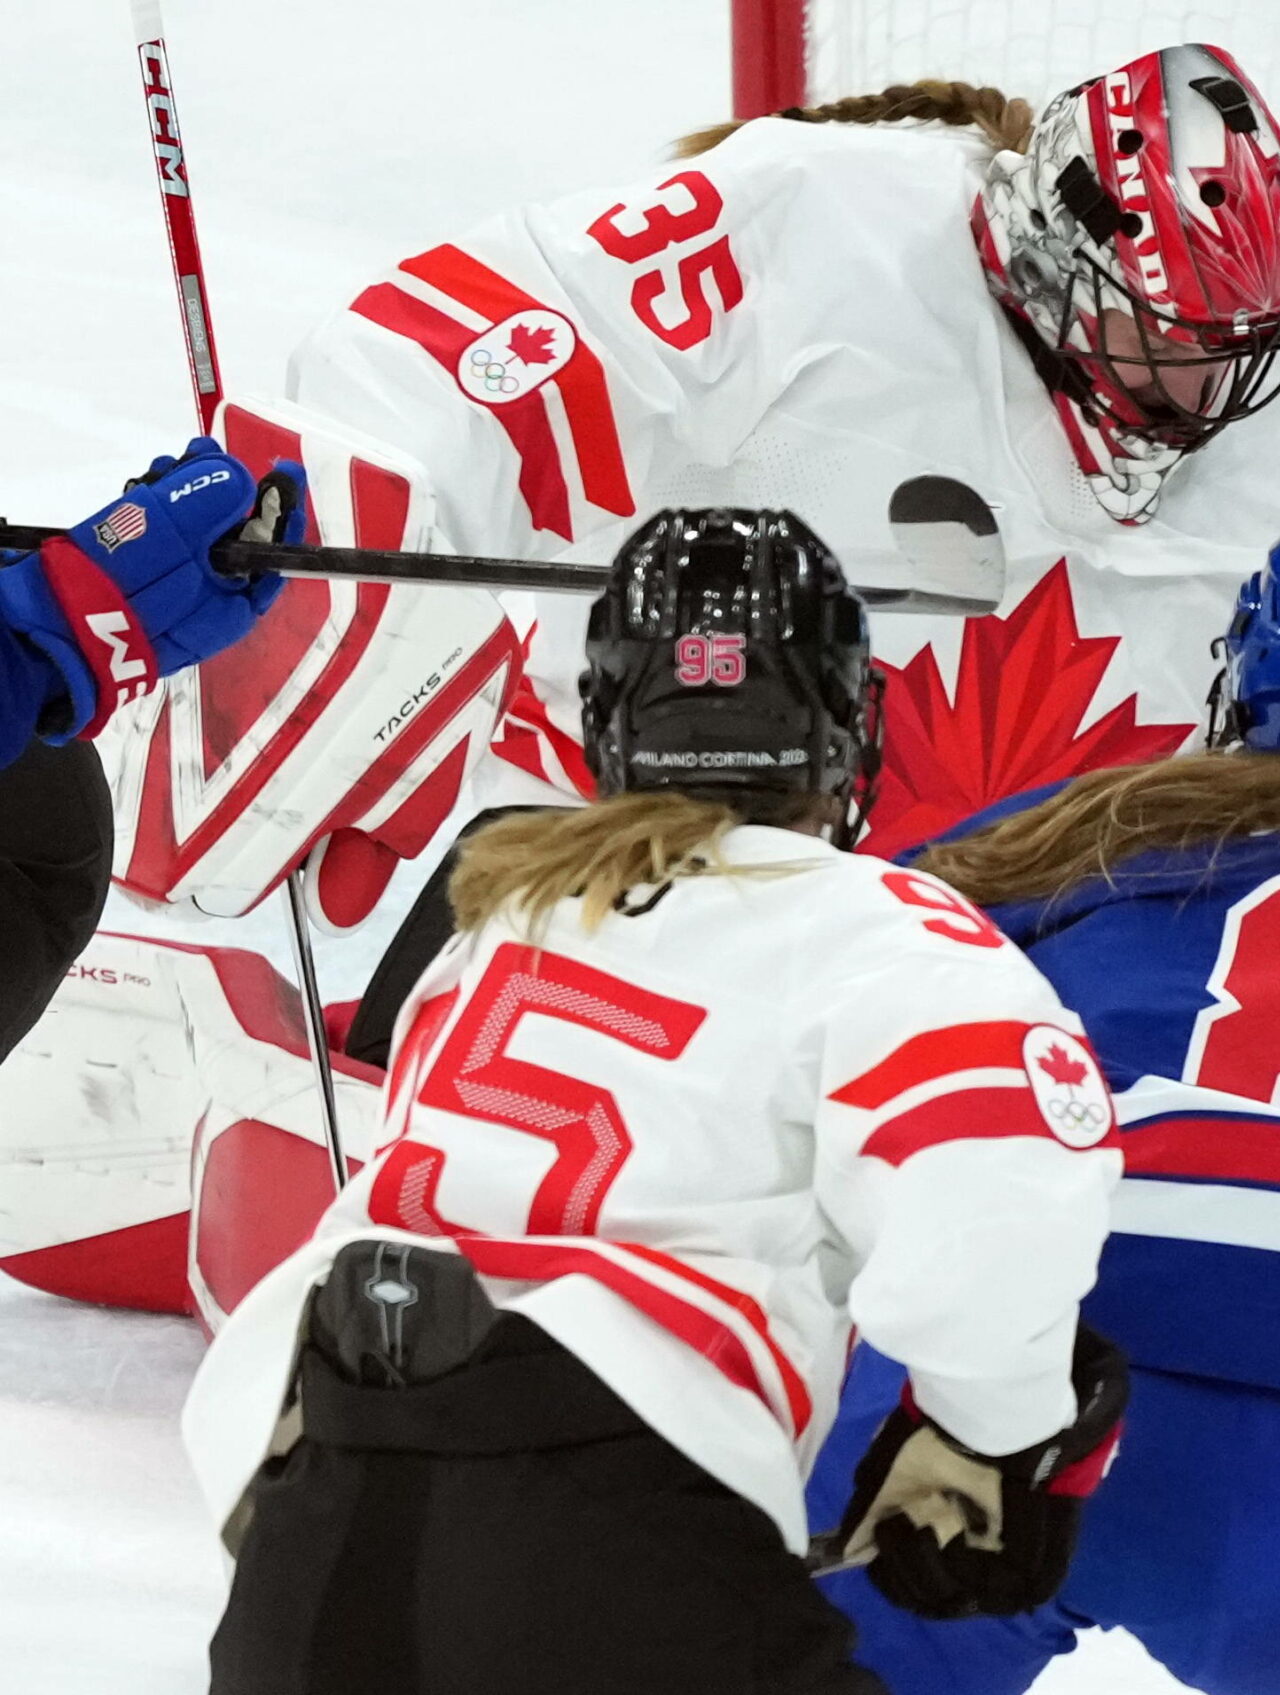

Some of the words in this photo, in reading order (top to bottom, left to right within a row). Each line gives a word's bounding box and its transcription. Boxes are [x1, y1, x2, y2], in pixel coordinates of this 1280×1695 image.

[140, 42, 189, 197] CCM
[586, 170, 743, 351] 35
[169, 470, 231, 503] CCM
[100, 524, 118, 545] USA
[373, 672, 441, 742] TACKS
[442, 647, 463, 670] PRO
[674, 633, 747, 687] 95
[631, 751, 698, 768] MILANO
[367, 940, 709, 1237] 5
